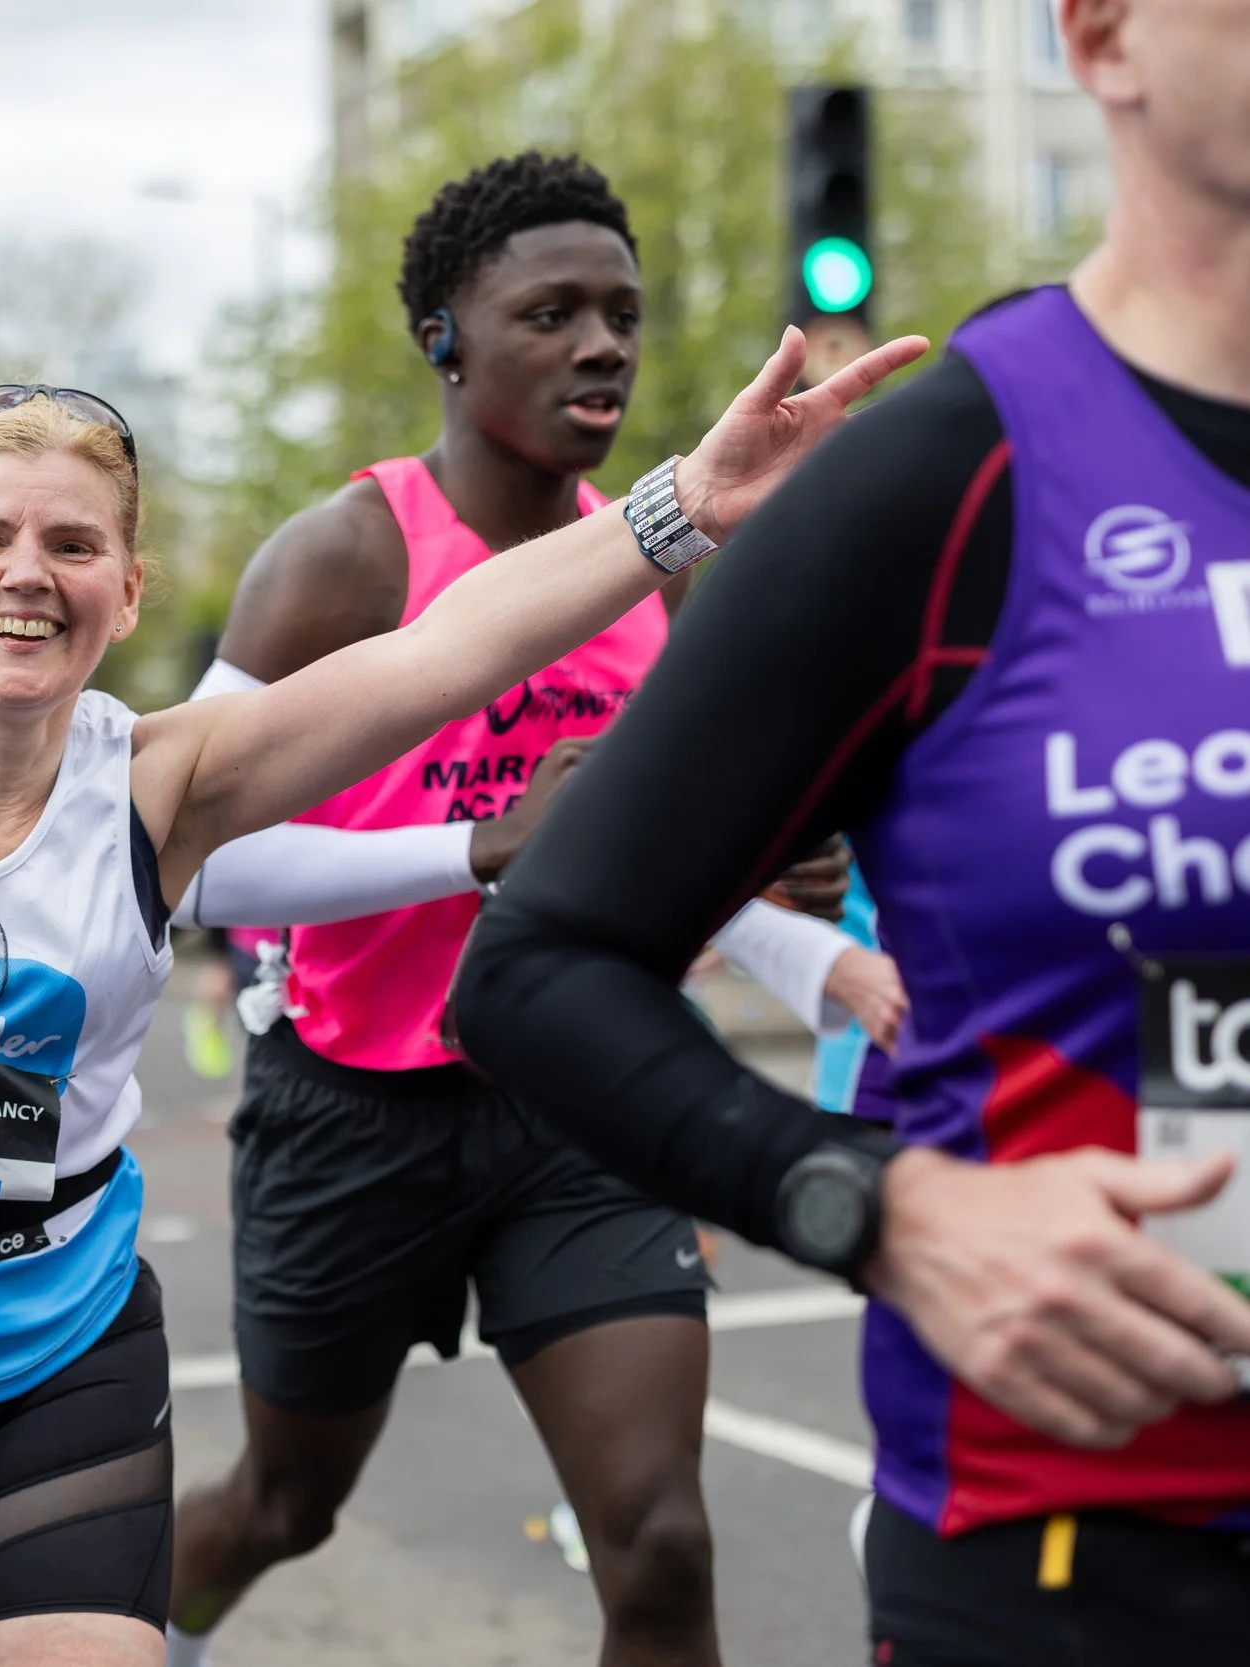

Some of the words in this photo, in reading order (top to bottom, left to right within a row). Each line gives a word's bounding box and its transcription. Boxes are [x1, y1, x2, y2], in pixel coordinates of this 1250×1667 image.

[642, 528, 654, 538] 25M
[647, 535, 659, 546] 26M
[652, 539, 670, 553] FINISH
[422, 755, 547, 790] MAR
[1051, 813, 1250, 918] Ch
